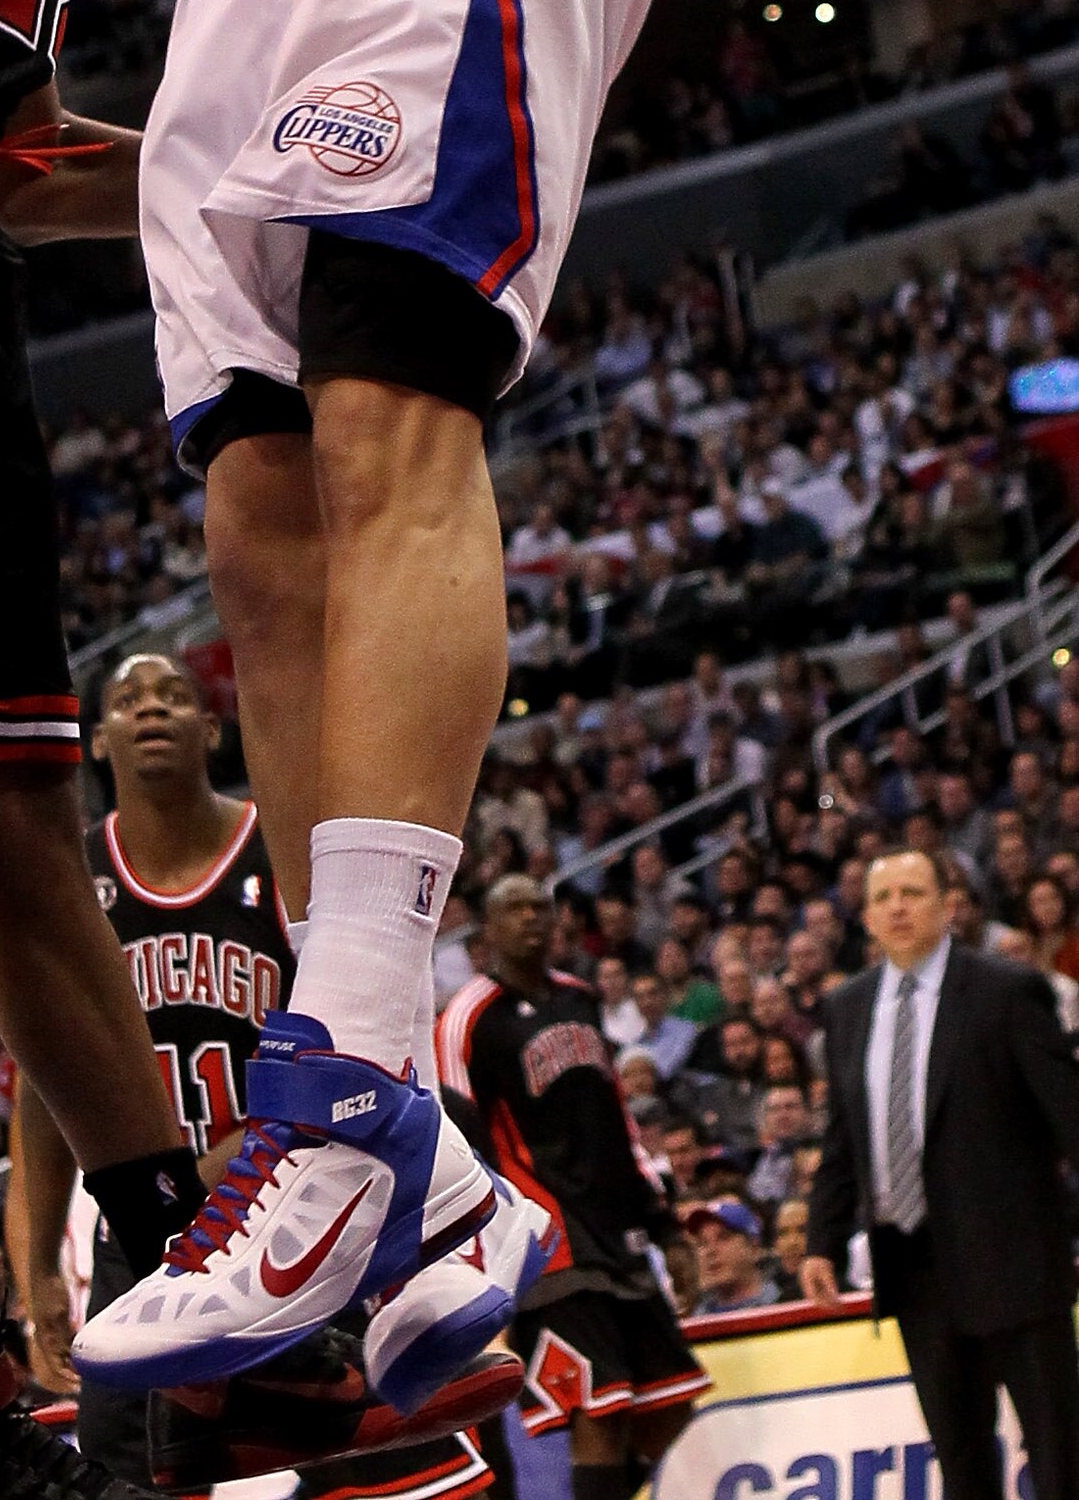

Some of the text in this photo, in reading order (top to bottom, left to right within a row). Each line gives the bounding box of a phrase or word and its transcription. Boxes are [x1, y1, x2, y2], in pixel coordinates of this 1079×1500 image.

[272, 104, 389, 158] CLIPPERS
[318, 106, 395, 134] LOS ANGELES
[122, 932, 282, 1030] ICAGO
[330, 1089, 378, 1125] BG32
